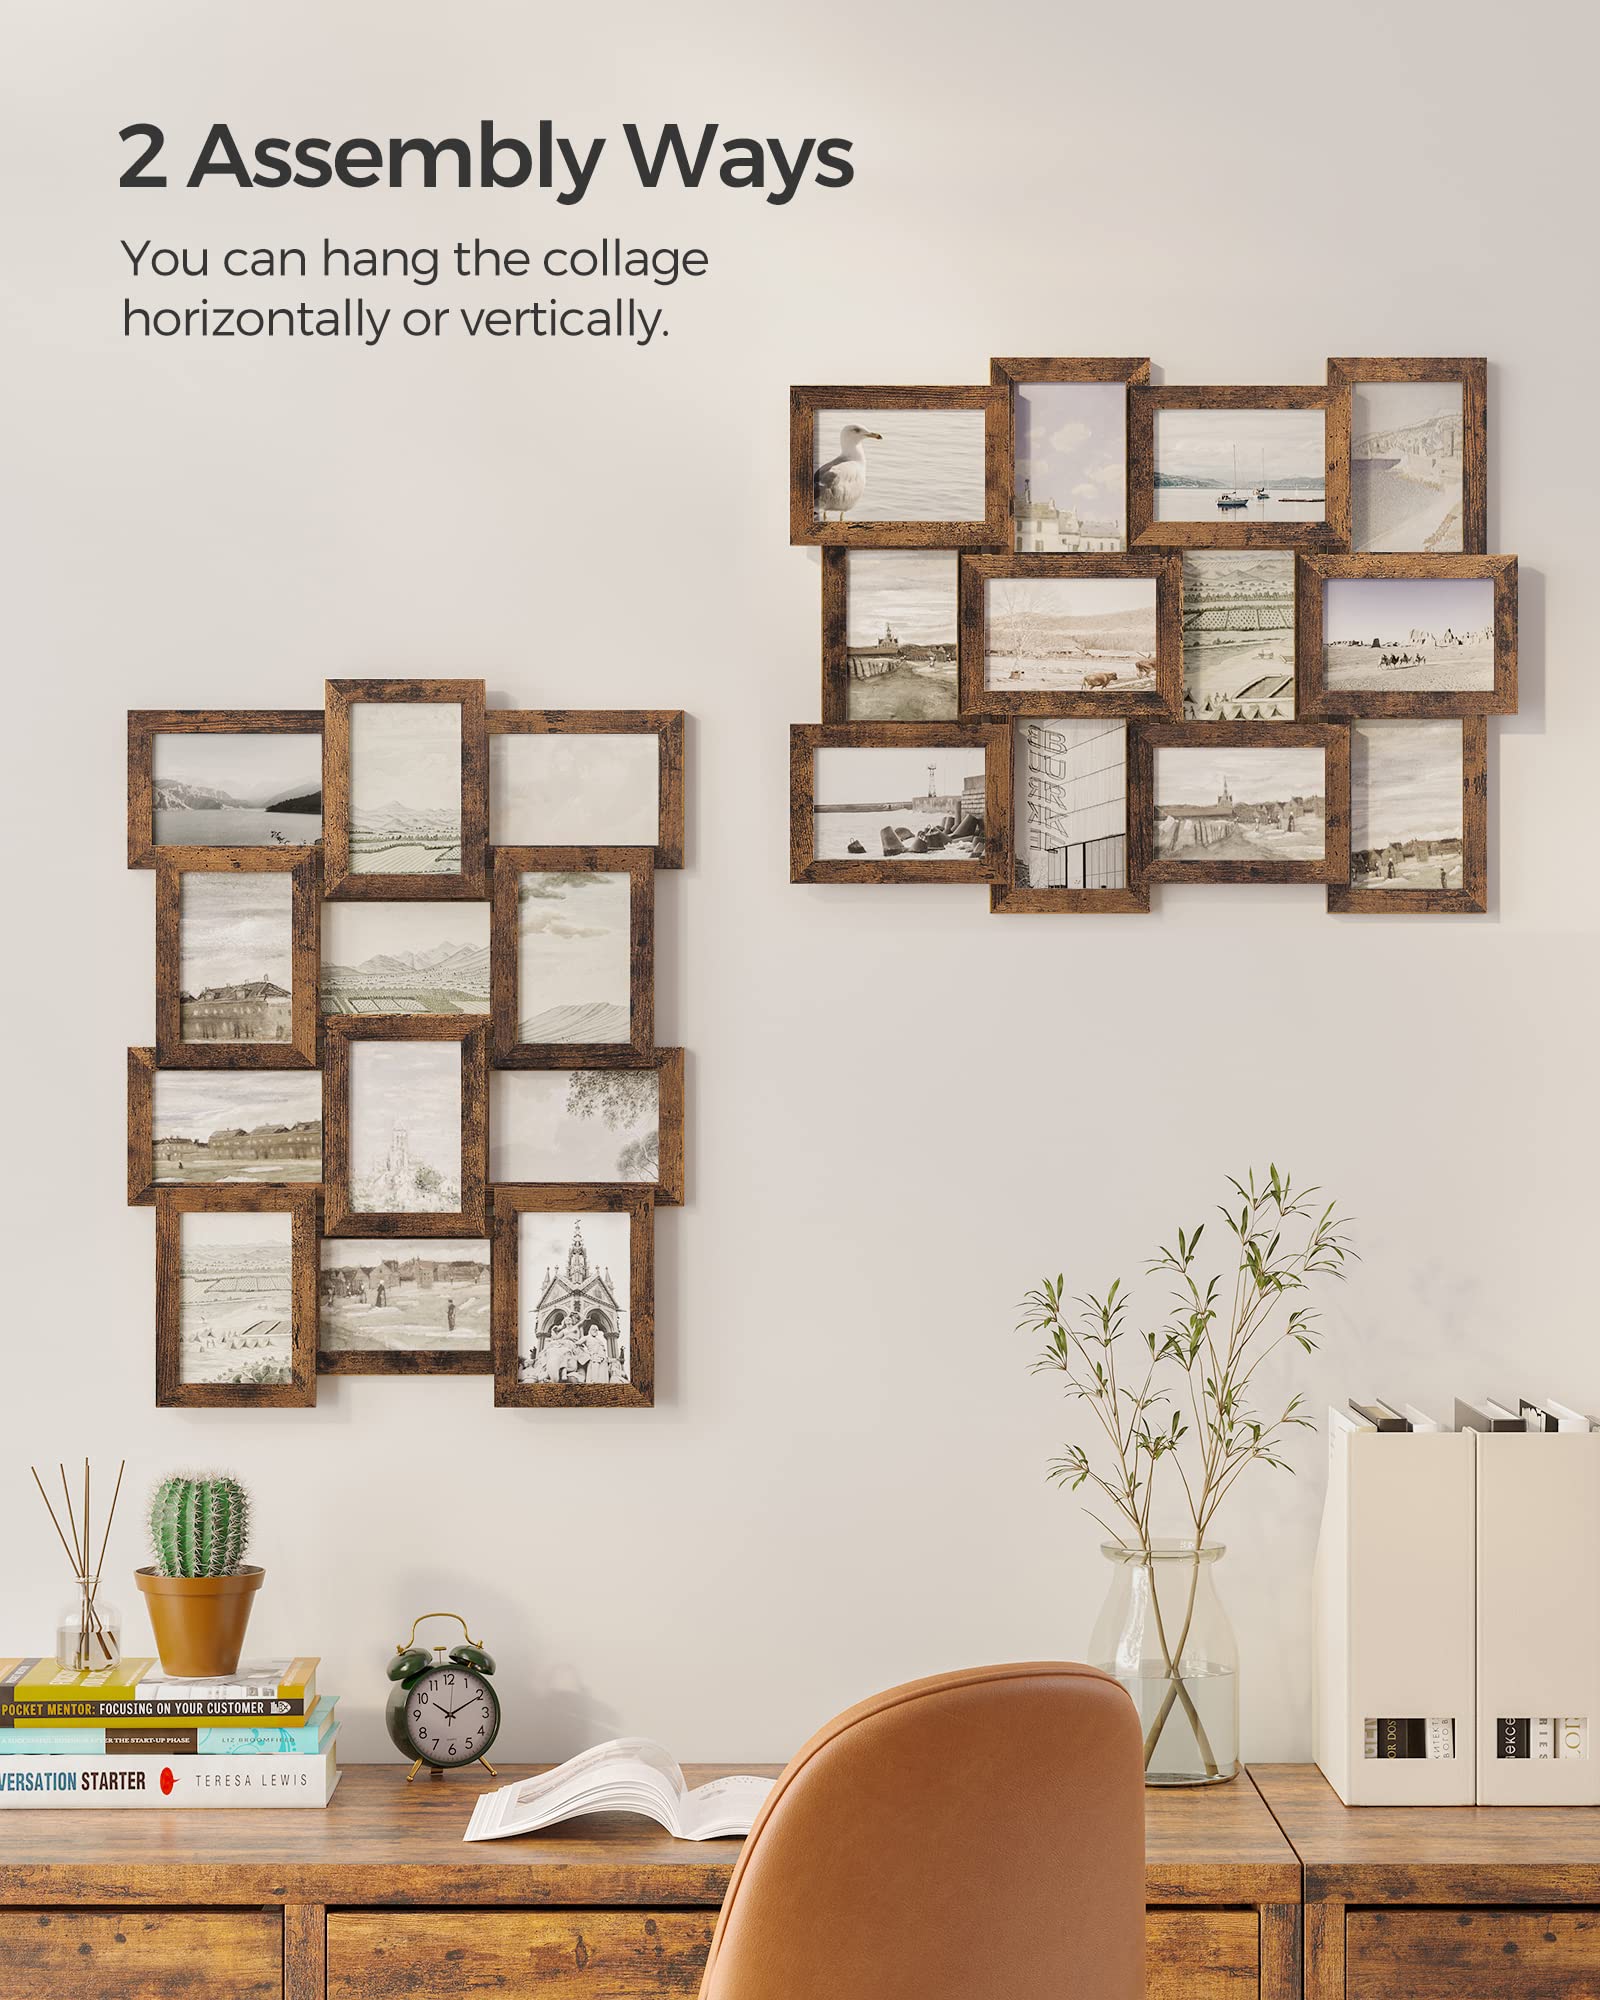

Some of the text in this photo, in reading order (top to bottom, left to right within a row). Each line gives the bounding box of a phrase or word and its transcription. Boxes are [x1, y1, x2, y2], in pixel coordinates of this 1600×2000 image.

[429, 1680, 439, 1691] 11
[443, 1673, 455, 1685] 12
[464, 1678, 468, 1689] 1
[417, 1692, 429, 1705] 10
[475, 1688, 484, 1701] 2
[1, 1701, 264, 1716] POCKET MENTOR: FOCUSING ON YOUR CUSTOMER
[481, 1706, 490, 1719] 3
[413, 1709, 422, 1722] 9
[419, 1726, 428, 1739] 8
[477, 1725, 485, 1736] 4
[1387, 1720, 1397, 1740] DOS
[432, 1738, 440, 1751] 7
[465, 1737, 474, 1750] 5
[1432, 1718, 1440, 1758] ИТЕКТ
[448, 1743, 457, 1756] 6
[0, 1771, 146, 1791] VERSATION STARTER
[196, 1773, 307, 1787] TERESA LEWIS
